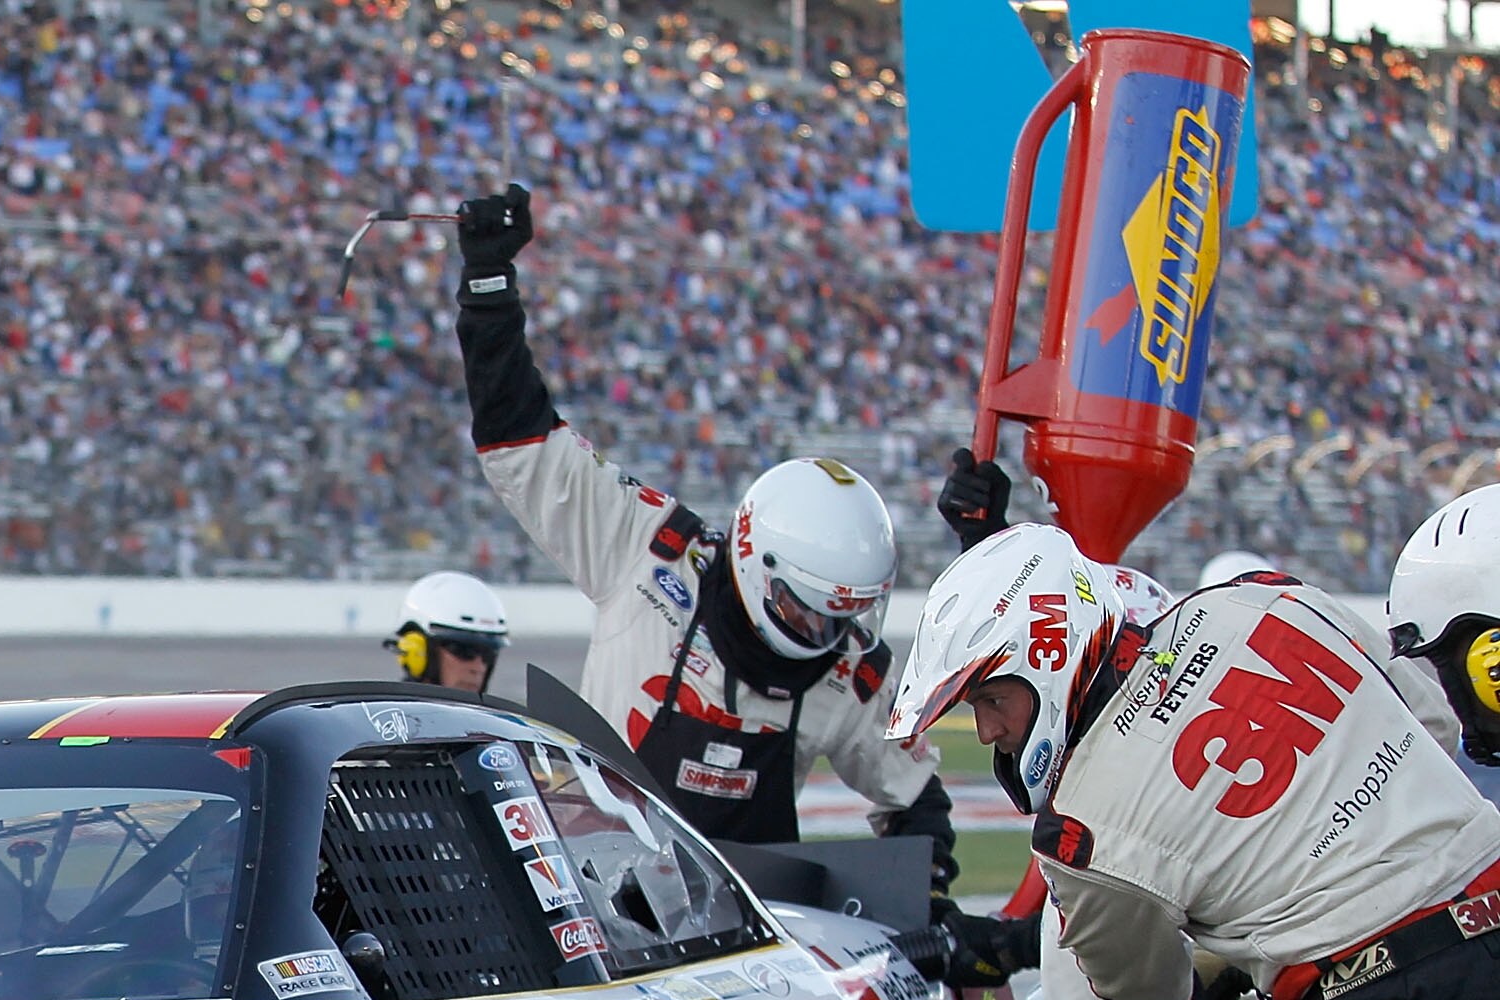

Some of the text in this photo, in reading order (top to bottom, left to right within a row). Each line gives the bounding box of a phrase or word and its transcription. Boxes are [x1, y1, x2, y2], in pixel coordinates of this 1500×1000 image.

[1146, 112, 1221, 380] SUNOCO
[636, 583, 680, 629] GOODYEAR
[658, 573, 689, 603] Ford
[992, 552, 1044, 618] 3M Innovation
[1070, 568, 1098, 606] 16
[1028, 593, 1069, 673] 3M
[1149, 641, 1220, 726] FETTERS
[1171, 612, 1364, 819] 3M
[1031, 748, 1050, 781] Ford
[1309, 731, 1416, 860] www.shop3M.com
[504, 801, 552, 842] 3M
[278, 974, 349, 993] RACE CAR
[293, 954, 337, 976] NASCAR
[1365, 958, 1396, 985] WEAR
